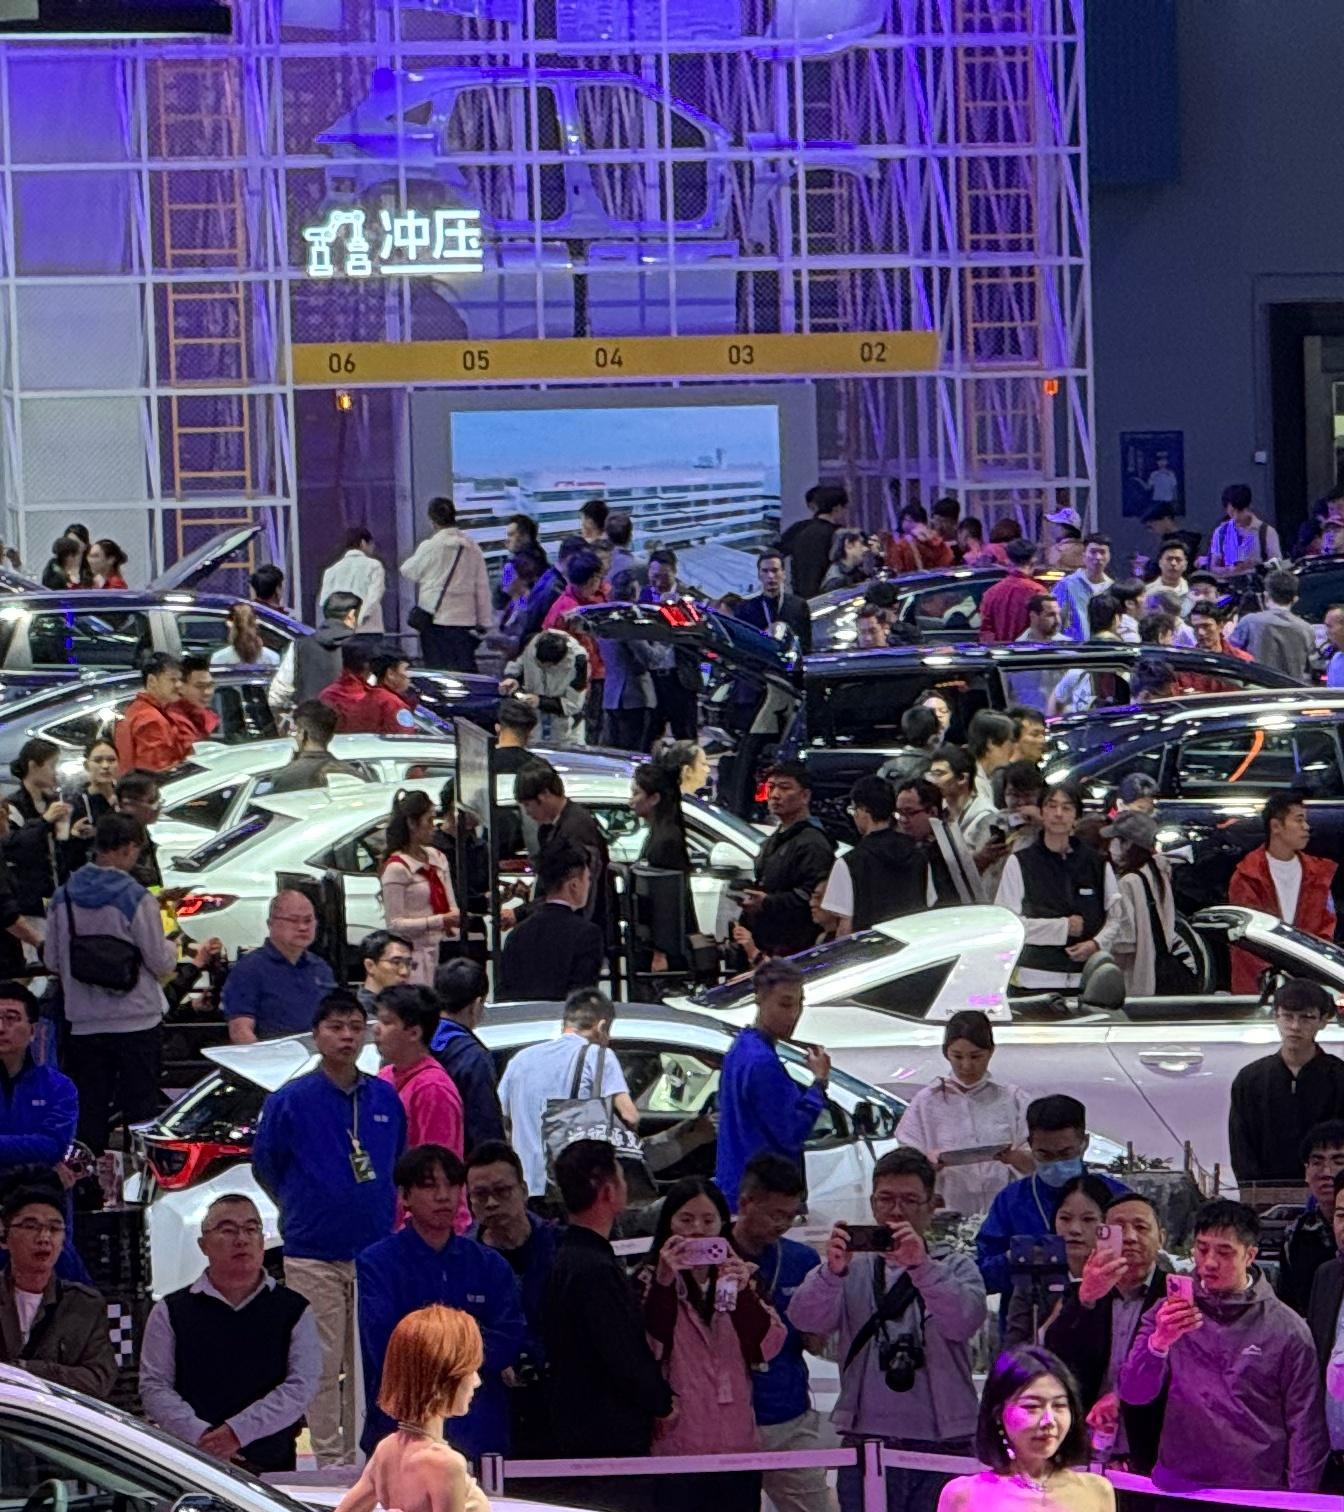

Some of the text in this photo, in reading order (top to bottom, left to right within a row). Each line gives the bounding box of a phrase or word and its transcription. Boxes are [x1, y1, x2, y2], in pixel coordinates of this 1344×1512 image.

[380, 209, 483, 260] 冲压
[328, 342, 887, 374] 06 05 04 03 02
